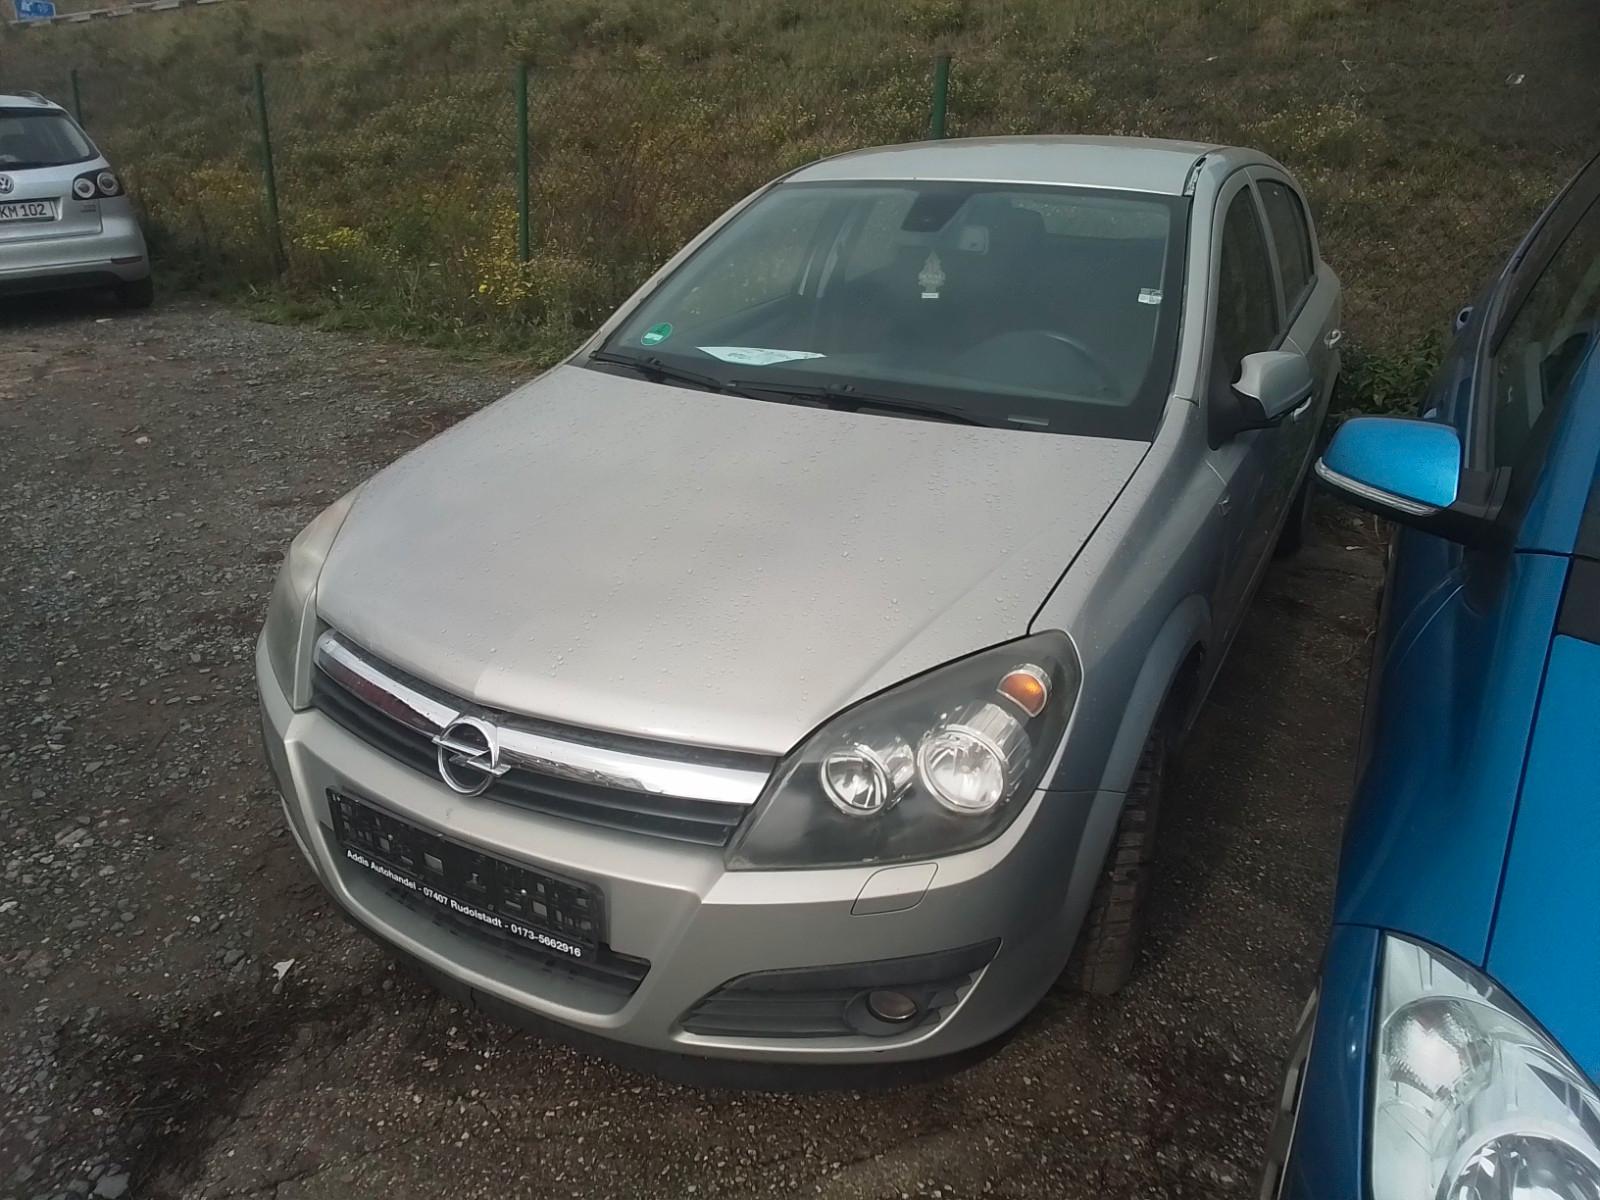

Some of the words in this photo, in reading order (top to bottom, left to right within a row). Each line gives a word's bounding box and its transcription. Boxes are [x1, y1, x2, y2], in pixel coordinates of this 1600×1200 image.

[21, 203, 47, 217] 102
[347, 849, 369, 867] Addis
[370, 861, 417, 890] Autohandel
[423, 886, 448, 905] 07407
[450, 899, 502, 928] Rudolstadt
[510, 923, 582, 957] 0173-5662916
